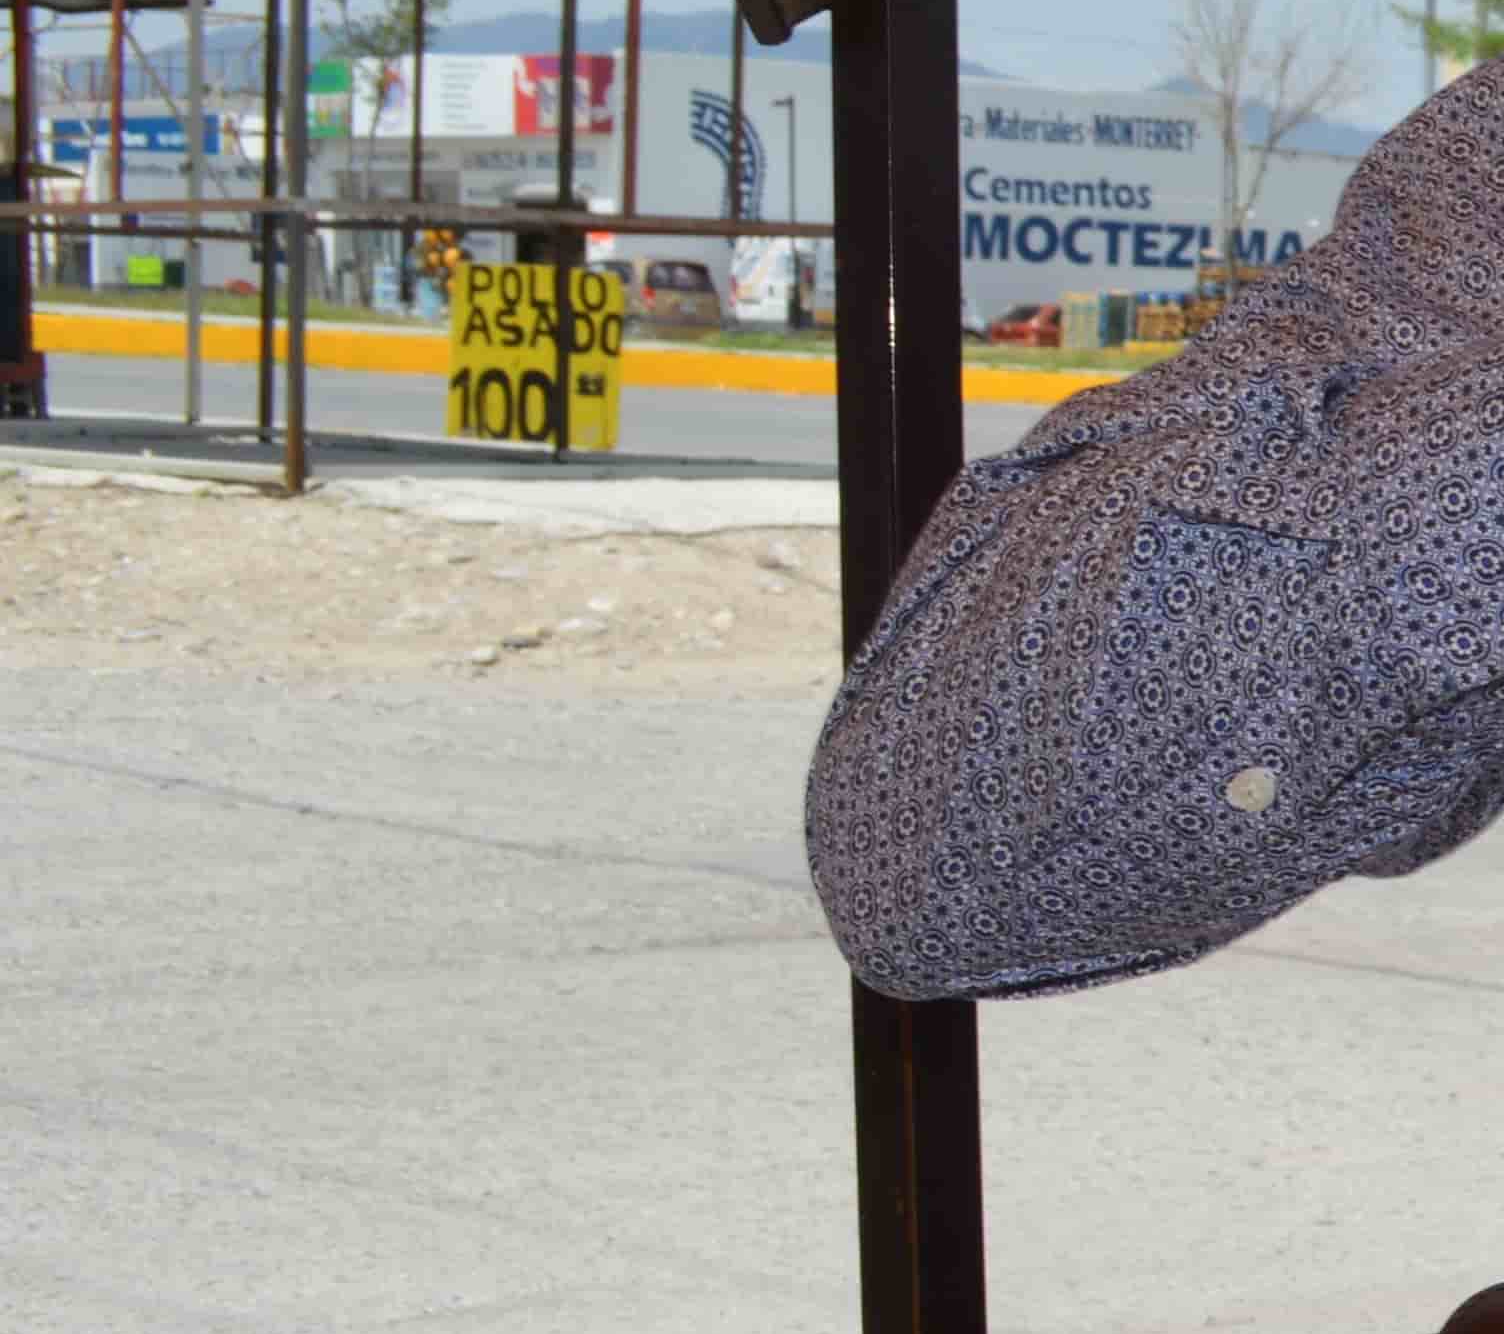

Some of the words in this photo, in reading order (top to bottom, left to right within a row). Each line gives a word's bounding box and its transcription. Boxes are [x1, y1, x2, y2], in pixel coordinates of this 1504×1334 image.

[985, 107, 1084, 145] Materiales
[1092, 113, 1197, 152] MONTERREY
[963, 166, 1153, 210] Cementos
[466, 266, 609, 314] POLO
[450, 365, 556, 442] 100
